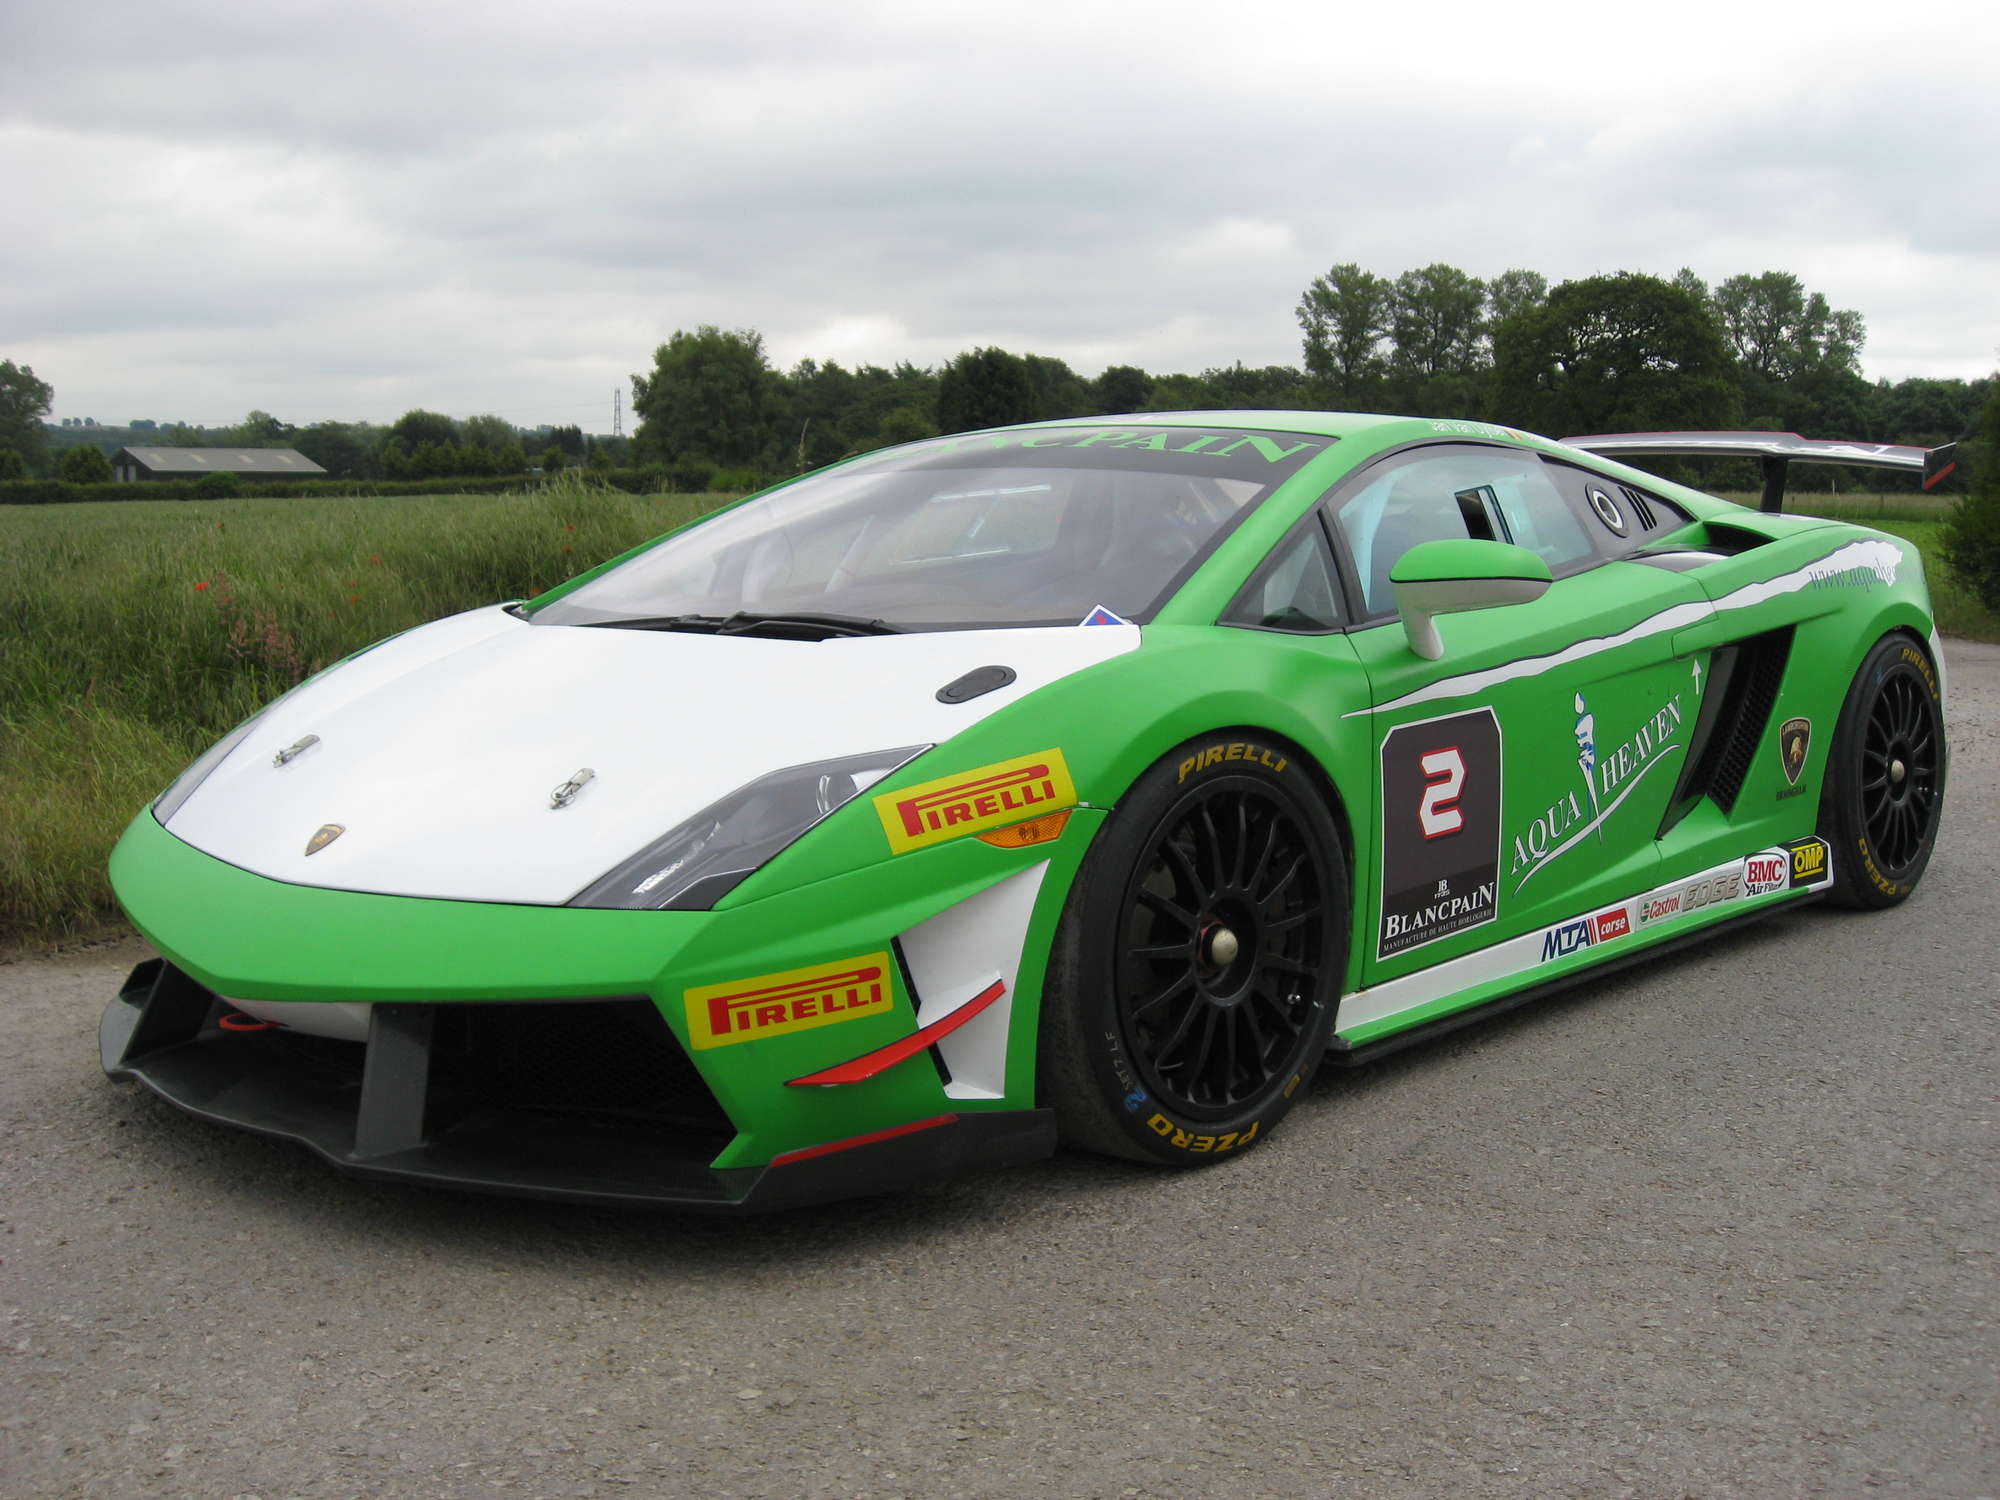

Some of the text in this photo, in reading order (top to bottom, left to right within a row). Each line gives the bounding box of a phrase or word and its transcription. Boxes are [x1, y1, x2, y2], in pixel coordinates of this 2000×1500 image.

[1178, 743, 1288, 785] PIRELLI
[1511, 694, 1682, 876] AQUA HEAVEN
[896, 764, 1057, 838] PIRELLI
[1417, 744, 1469, 840] 2
[1746, 858, 1783, 883] BMC
[1794, 846, 1825, 873] OMP
[1649, 894, 1681, 919] Castrol
[1682, 872, 1742, 912] EDGE
[1541, 919, 1592, 963] MTA
[1600, 917, 1626, 936] corse
[707, 966, 882, 1036] PIRELLI
